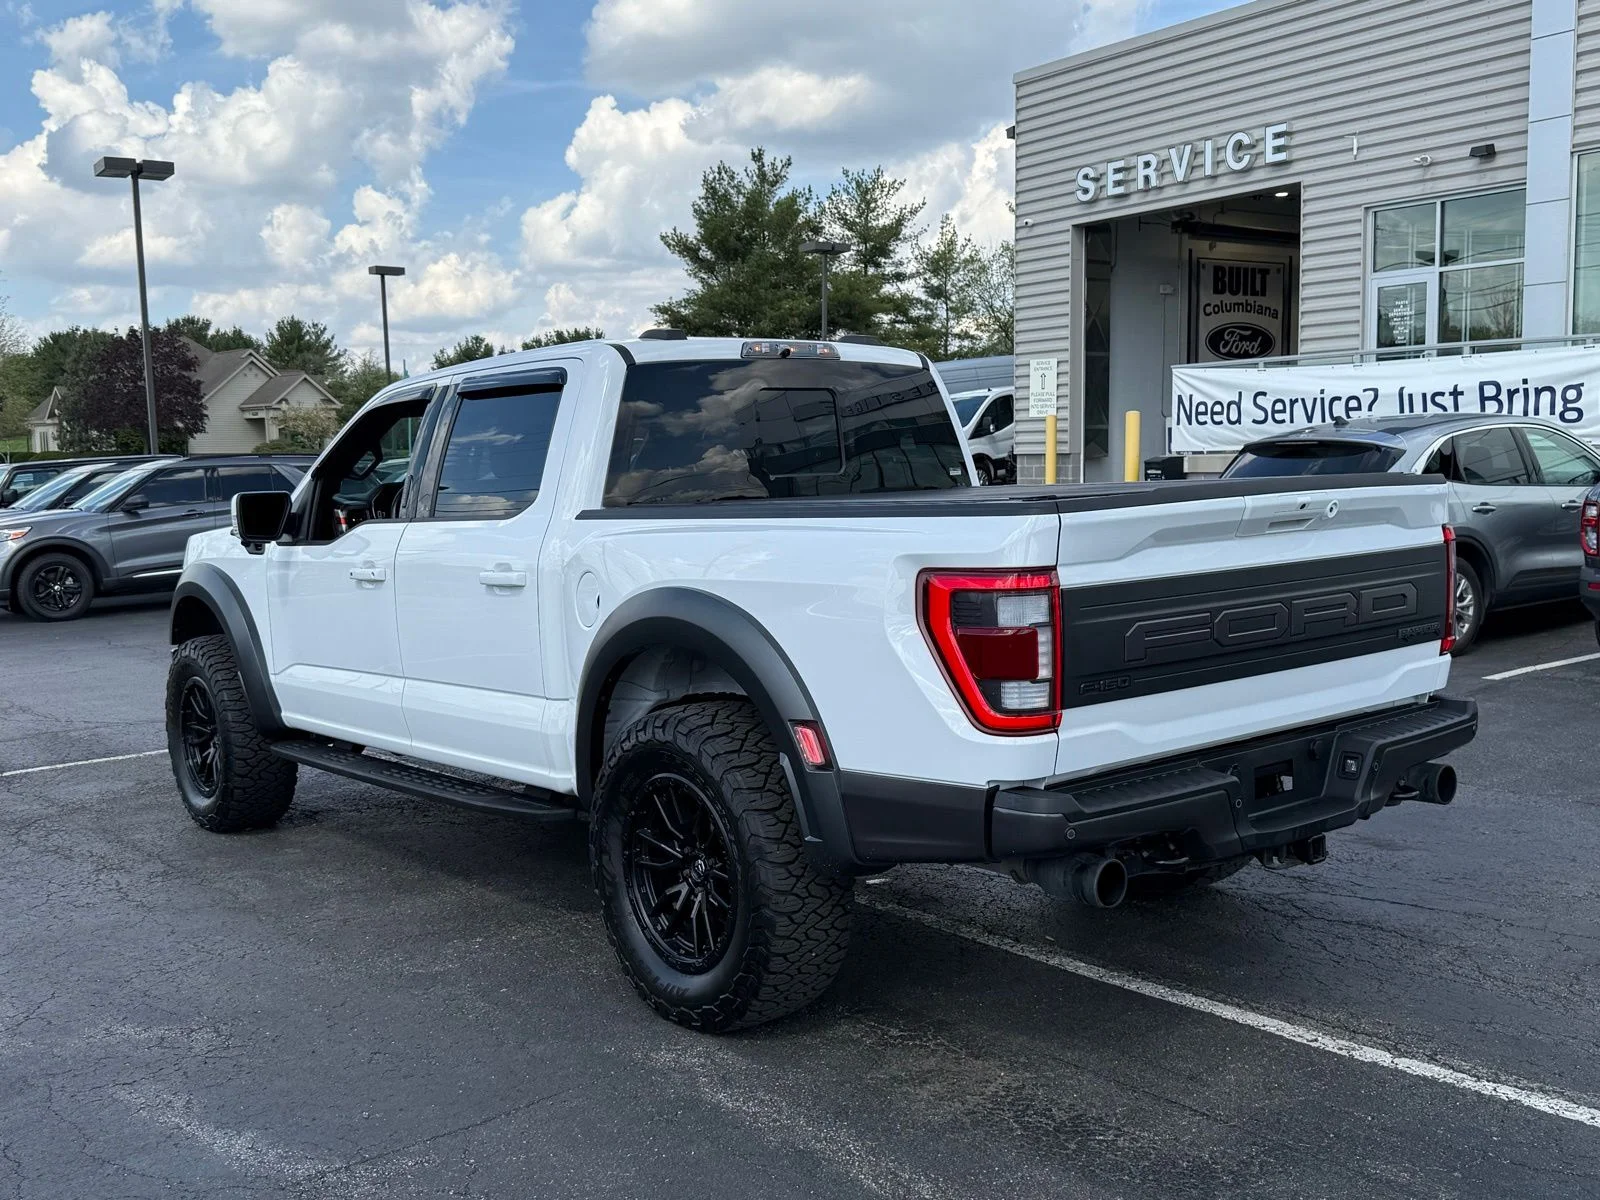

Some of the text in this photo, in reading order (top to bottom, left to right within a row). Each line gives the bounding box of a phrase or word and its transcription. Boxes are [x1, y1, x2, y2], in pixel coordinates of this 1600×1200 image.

[1075, 122, 1290, 202] SERVICE
[1212, 265, 1271, 297] BUILT
[1203, 299, 1279, 320] Columbiana
[1220, 328, 1263, 354] Ford
[1176, 391, 1243, 426] Need
[1251, 387, 1380, 425] Service?
[1478, 378, 1585, 423] Bring
[1124, 582, 1418, 664] FORD
